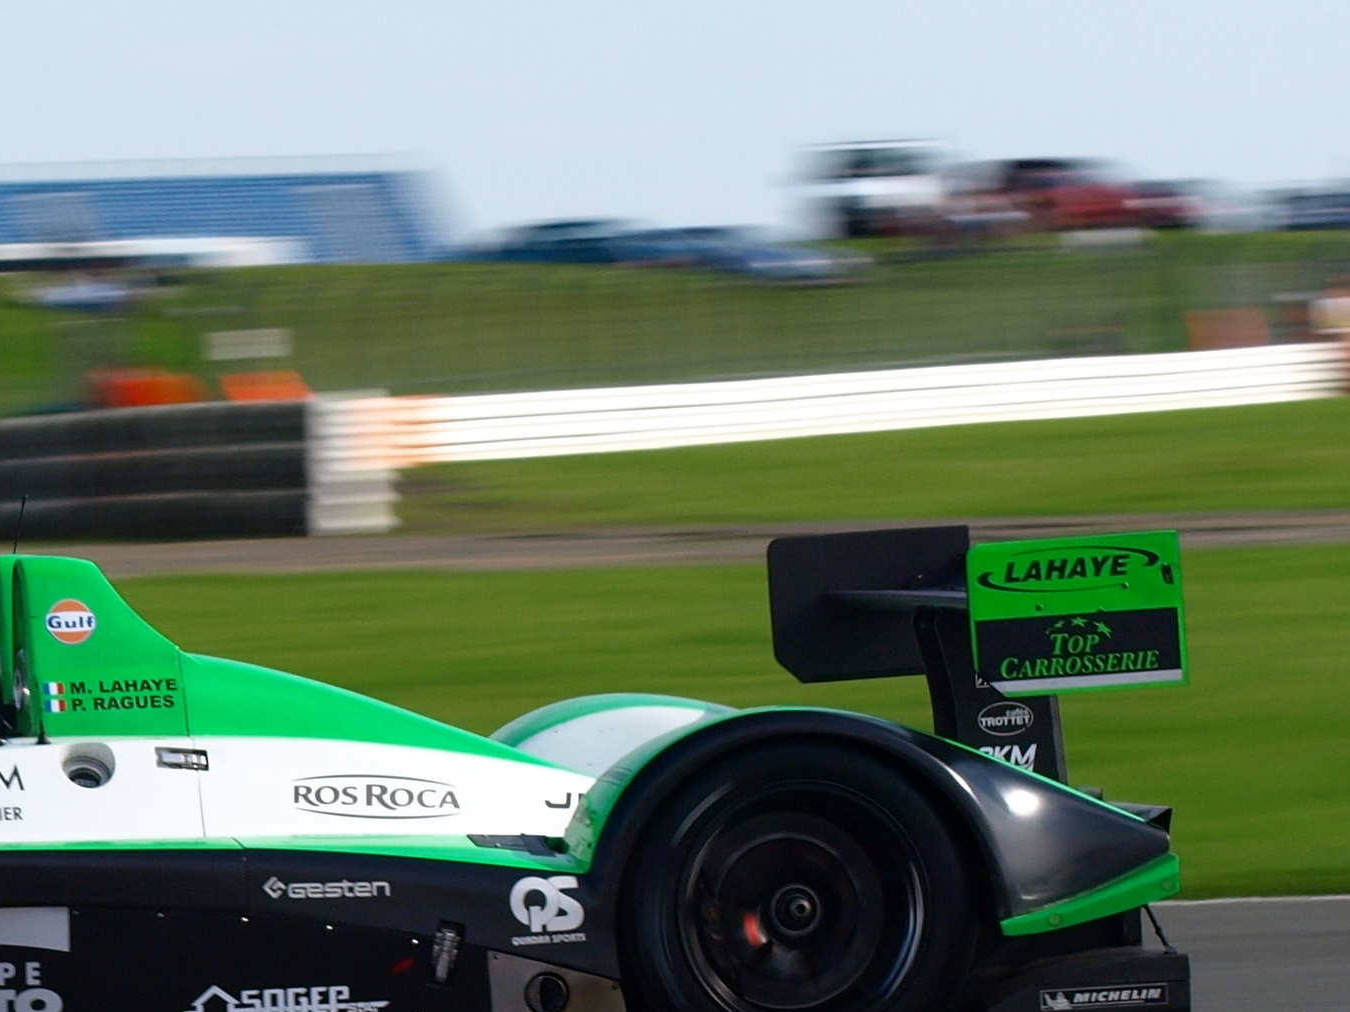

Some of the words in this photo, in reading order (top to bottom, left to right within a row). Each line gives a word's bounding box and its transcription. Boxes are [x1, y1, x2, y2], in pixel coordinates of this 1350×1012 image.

[1004, 554, 1131, 583] LAHAYE
[48, 615, 95, 629] Gulf
[1050, 633, 1101, 655] TOP
[1000, 650, 1159, 679] CARROSSERIE
[70, 682, 92, 694] M.
[99, 679, 177, 693] LAHAYE
[72, 699, 86, 711] P.
[93, 695, 175, 710] RAGUES
[981, 716, 1030, 727] TROTTET
[510, 875, 585, 933] QS
[1073, 987, 1161, 1003] MICHELIN
